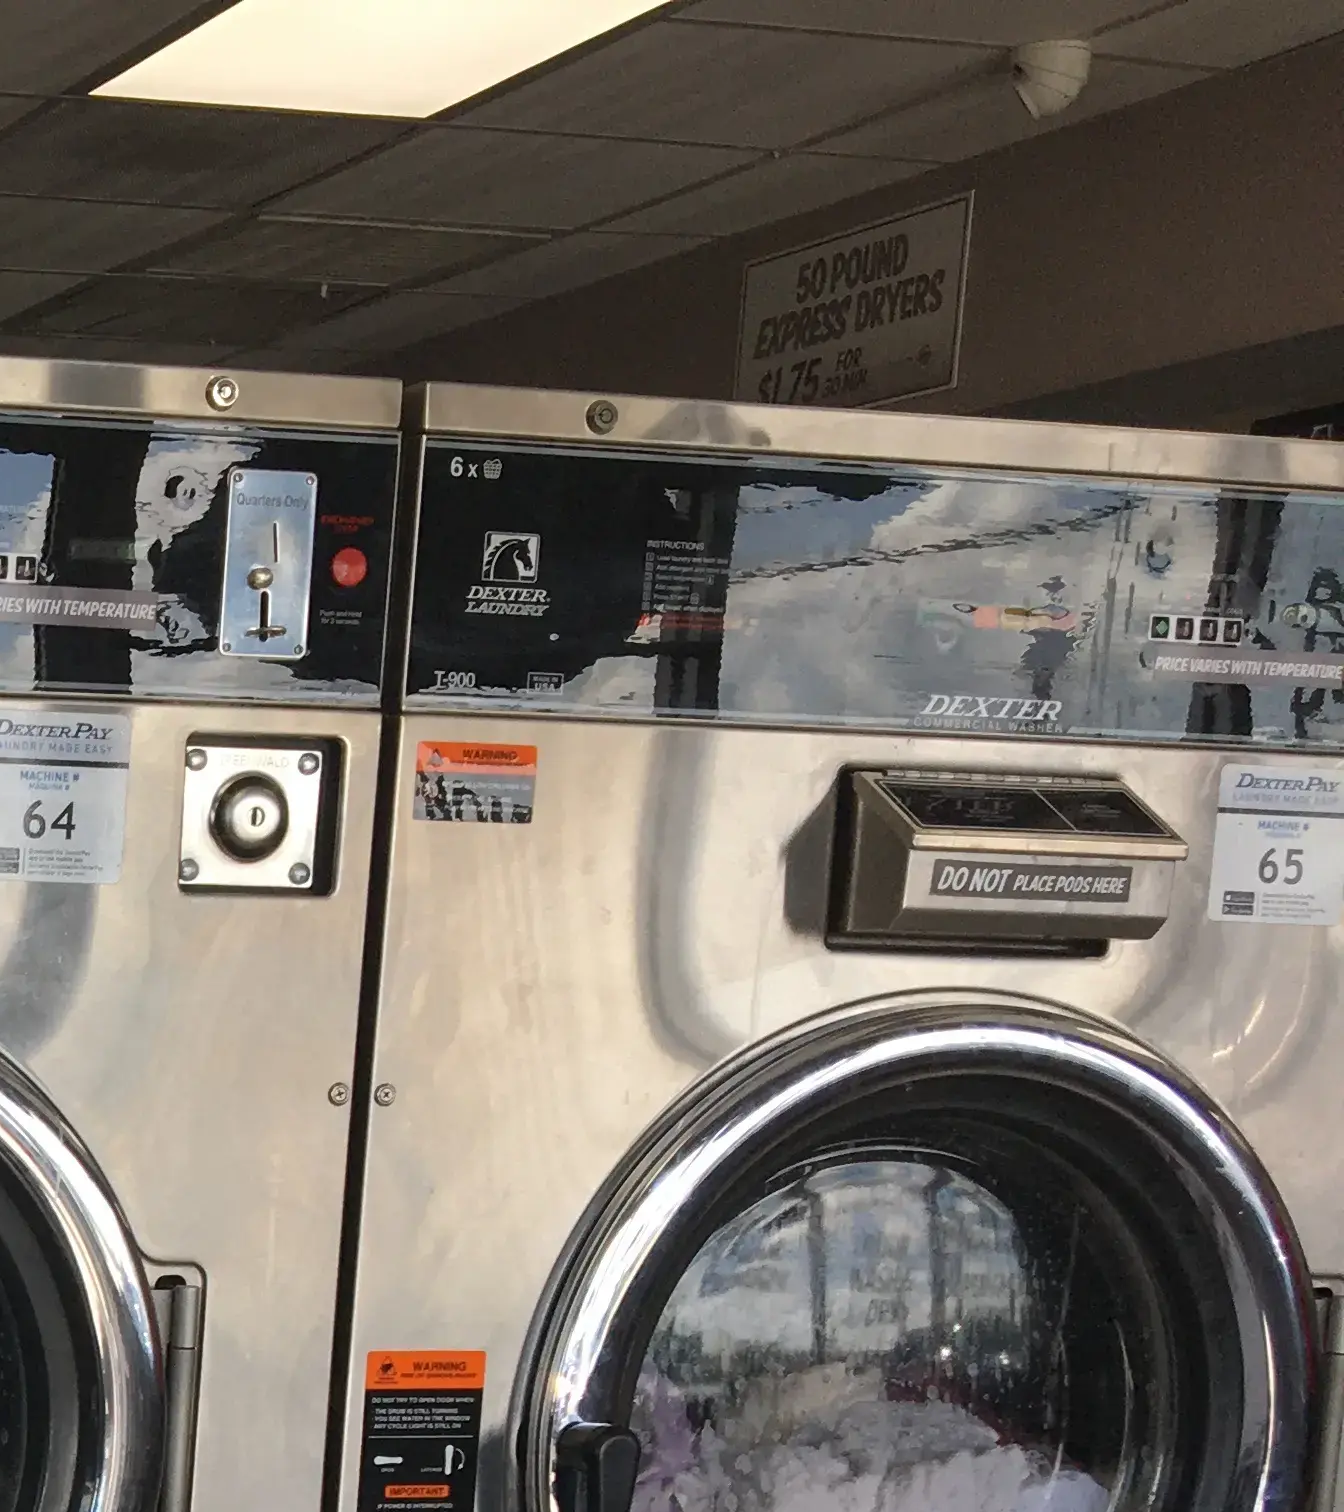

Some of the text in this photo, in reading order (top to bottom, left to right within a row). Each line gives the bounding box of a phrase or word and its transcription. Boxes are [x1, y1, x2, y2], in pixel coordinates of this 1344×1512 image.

[796, 233, 909, 304] 50 POUND
[753, 268, 945, 359] EXPRESS DRYERS
[835, 347, 862, 372] FOR
[757, 357, 822, 405] $175
[450, 456, 478, 479] 6 x
[237, 493, 308, 511] Quarters Only
[647, 540, 705, 551] INSTRUCTIONS
[466, 585, 547, 602] DEXTER
[25, 598, 61, 615] WITH
[64, 601, 156, 620] TEMPERATURE
[465, 601, 549, 617] LAUNDRY
[1155, 656, 1343, 680] PRICE VARIES WITH TEMPERATURE
[434, 670, 476, 689] T-900
[534, 682, 556, 692] USA
[919, 694, 1062, 721] DEXTER
[913, 716, 1063, 733] COMMERCIAL WASHER
[48, 743, 79, 753] MADE
[85, 744, 112, 754] EASY
[462, 749, 518, 760] WARNING
[20, 771, 69, 782] MACHINE
[23, 800, 76, 840] 64
[1257, 820, 1299, 831] MACHINE
[1258, 848, 1304, 885] 65
[938, 865, 1127, 895] DO NOT PLACE PODS HERE
[413, 1362, 466, 1371] WARNING
[390, 1488, 445, 1496] IMPORTANT
